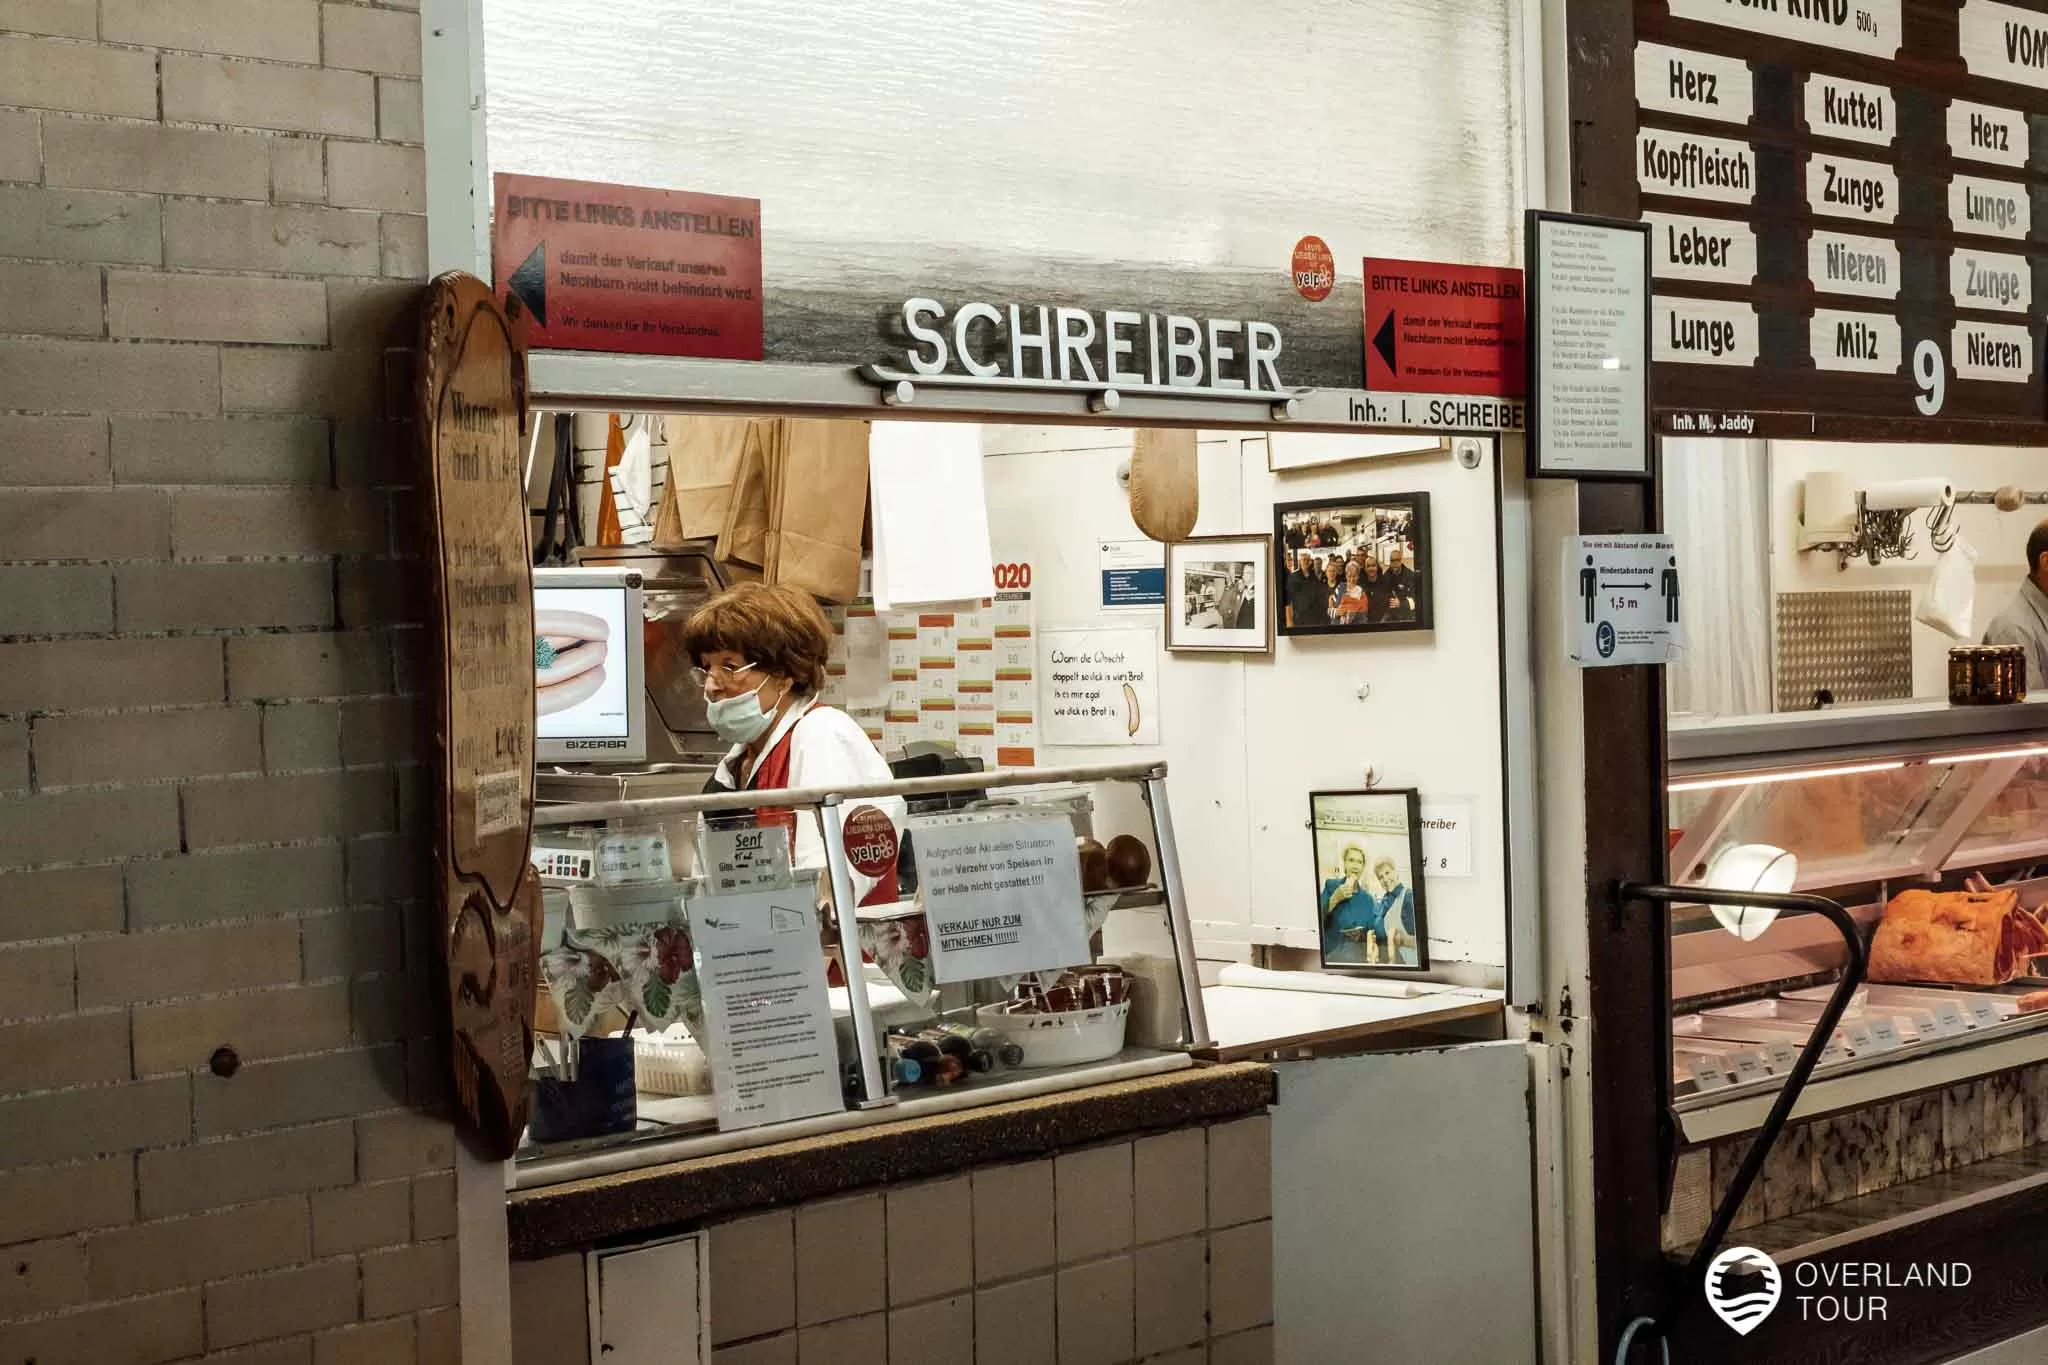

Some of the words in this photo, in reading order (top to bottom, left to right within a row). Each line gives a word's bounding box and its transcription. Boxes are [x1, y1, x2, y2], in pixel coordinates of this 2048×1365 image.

[1856, 10, 1871, 33] 500
[1669, 59, 1718, 105] Herz
[1824, 87, 1883, 132] Kuttel
[1970, 112, 2009, 152] Herz
[1643, 139, 1750, 190] Kopffleisch
[1824, 165, 1885, 213] Zunge
[506, 194, 569, 222] BITTE
[575, 202, 636, 229] LINKS
[640, 208, 755, 238] ANSTELLEN
[1966, 186, 2017, 230] Lunge
[560, 248, 599, 268] damit
[1668, 224, 1731, 268] Leber
[1826, 242, 1887, 285] Nieren
[1296, 271, 1320, 288] yelp
[1372, 275, 1408, 292] BITTE
[1412, 277, 1448, 296] LINKS
[1451, 280, 1521, 301] ANSTELLEN
[1965, 259, 2020, 306] Zunge
[902, 298, 1283, 393] SCHREIBER
[1670, 310, 1736, 357] Lunge
[1836, 321, 1879, 361] Milz
[1967, 331, 2022, 370] Nieren
[1913, 339, 1945, 416] 9
[1350, 397, 1387, 423] Inh.:
[1672, 414, 1696, 431] Inh.
[1719, 415, 1755, 434] Jaddy
[992, 563, 1031, 589] 020
[1610, 597, 1625, 610] 1,5
[1627, 599, 1638, 609] m
[566, 741, 627, 749] BIZERBA
[735, 832, 763, 848] Senf
[851, 844, 881, 864] yelp
[955, 863, 987, 874] Verzehr
[989, 861, 1005, 870] von
[1007, 859, 1042, 870] Speisen
[1440, 859, 1447, 869] 8
[948, 884, 969, 893] Halle
[971, 880, 993, 891] nicht
[994, 877, 1030, 891] gestattet
[937, 919, 980, 933] VERKAUF
[982, 916, 1000, 928] NUR
[1002, 913, 1021, 926] ZUM
[941, 934, 993, 949] MITNEHMEN
